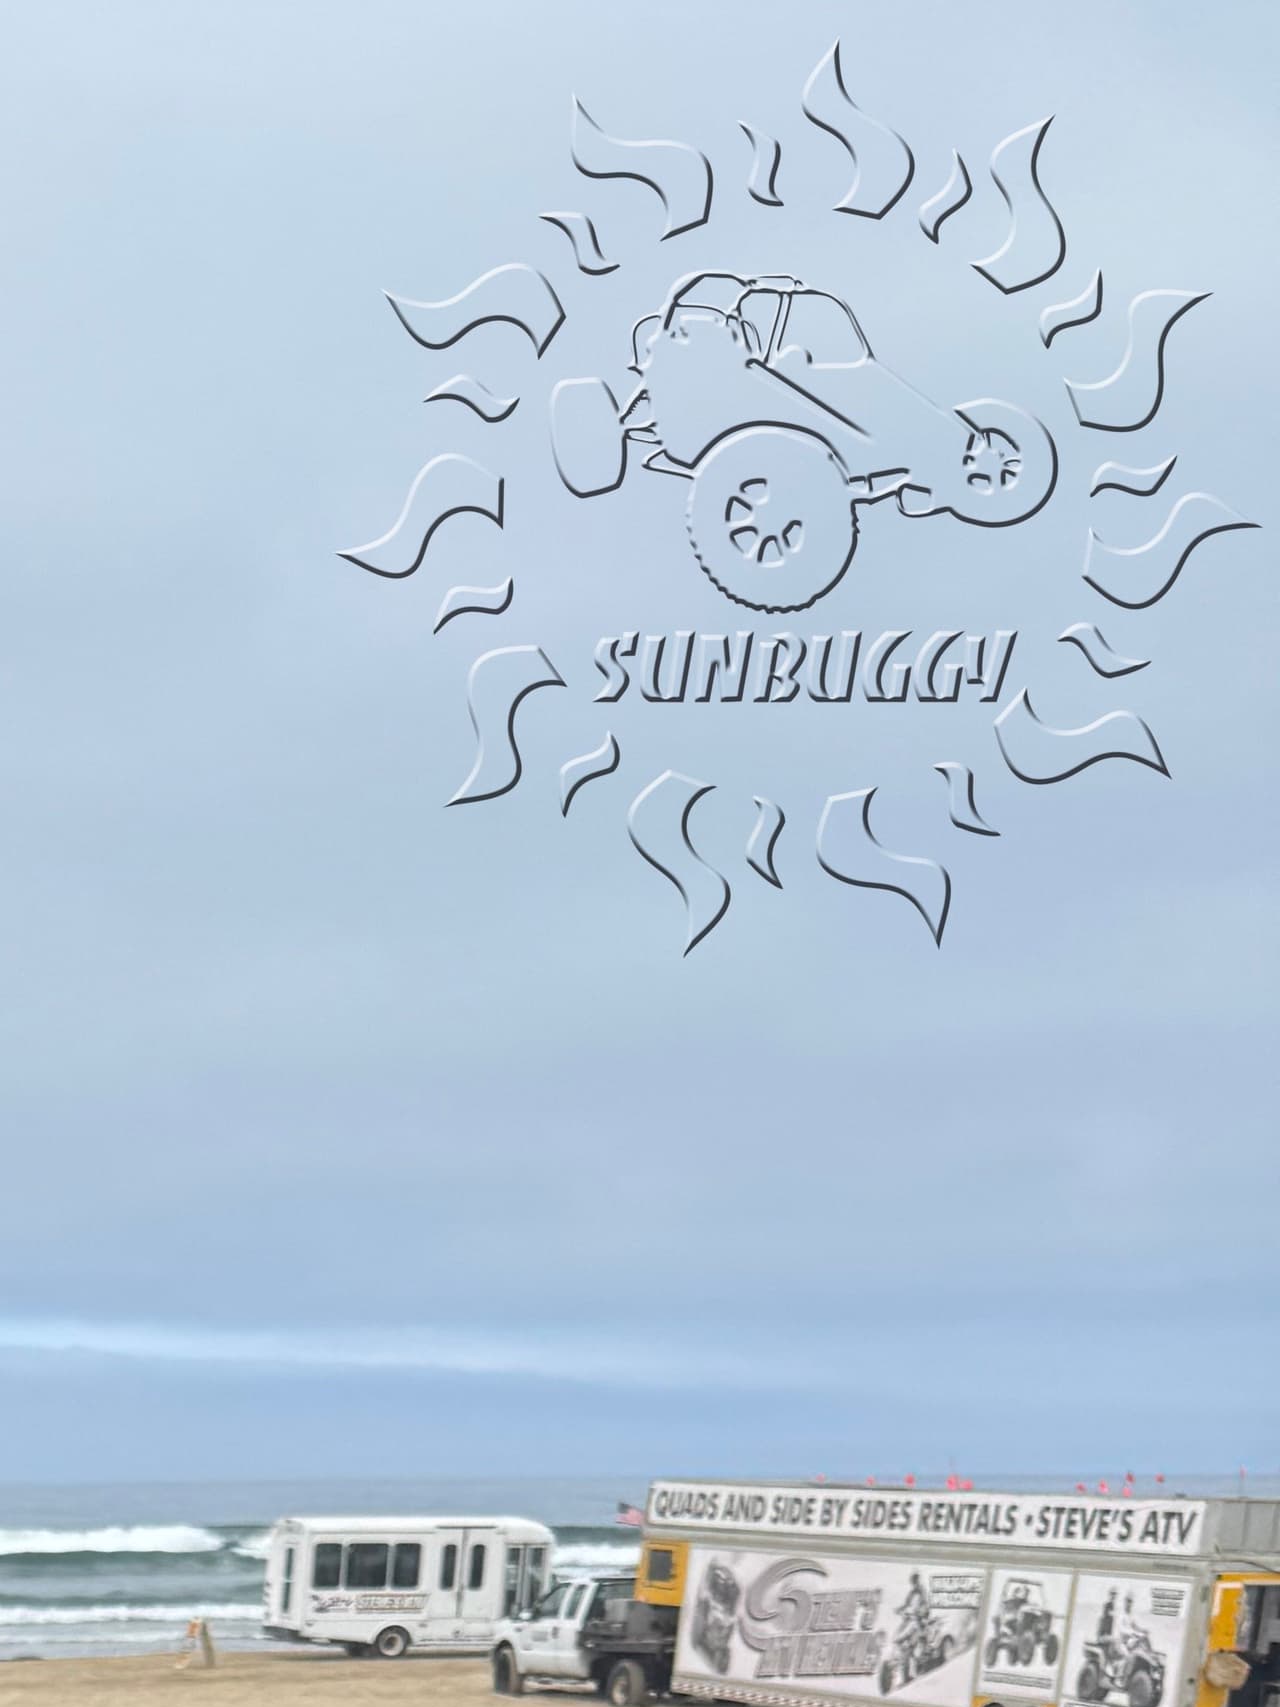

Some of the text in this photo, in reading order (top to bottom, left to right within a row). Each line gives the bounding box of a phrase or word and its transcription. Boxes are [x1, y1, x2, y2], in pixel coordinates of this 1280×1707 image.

[654, 1490, 1198, 1545] QUADS AND SIDE BY SIDES RENTALS STEVE'S ATV
